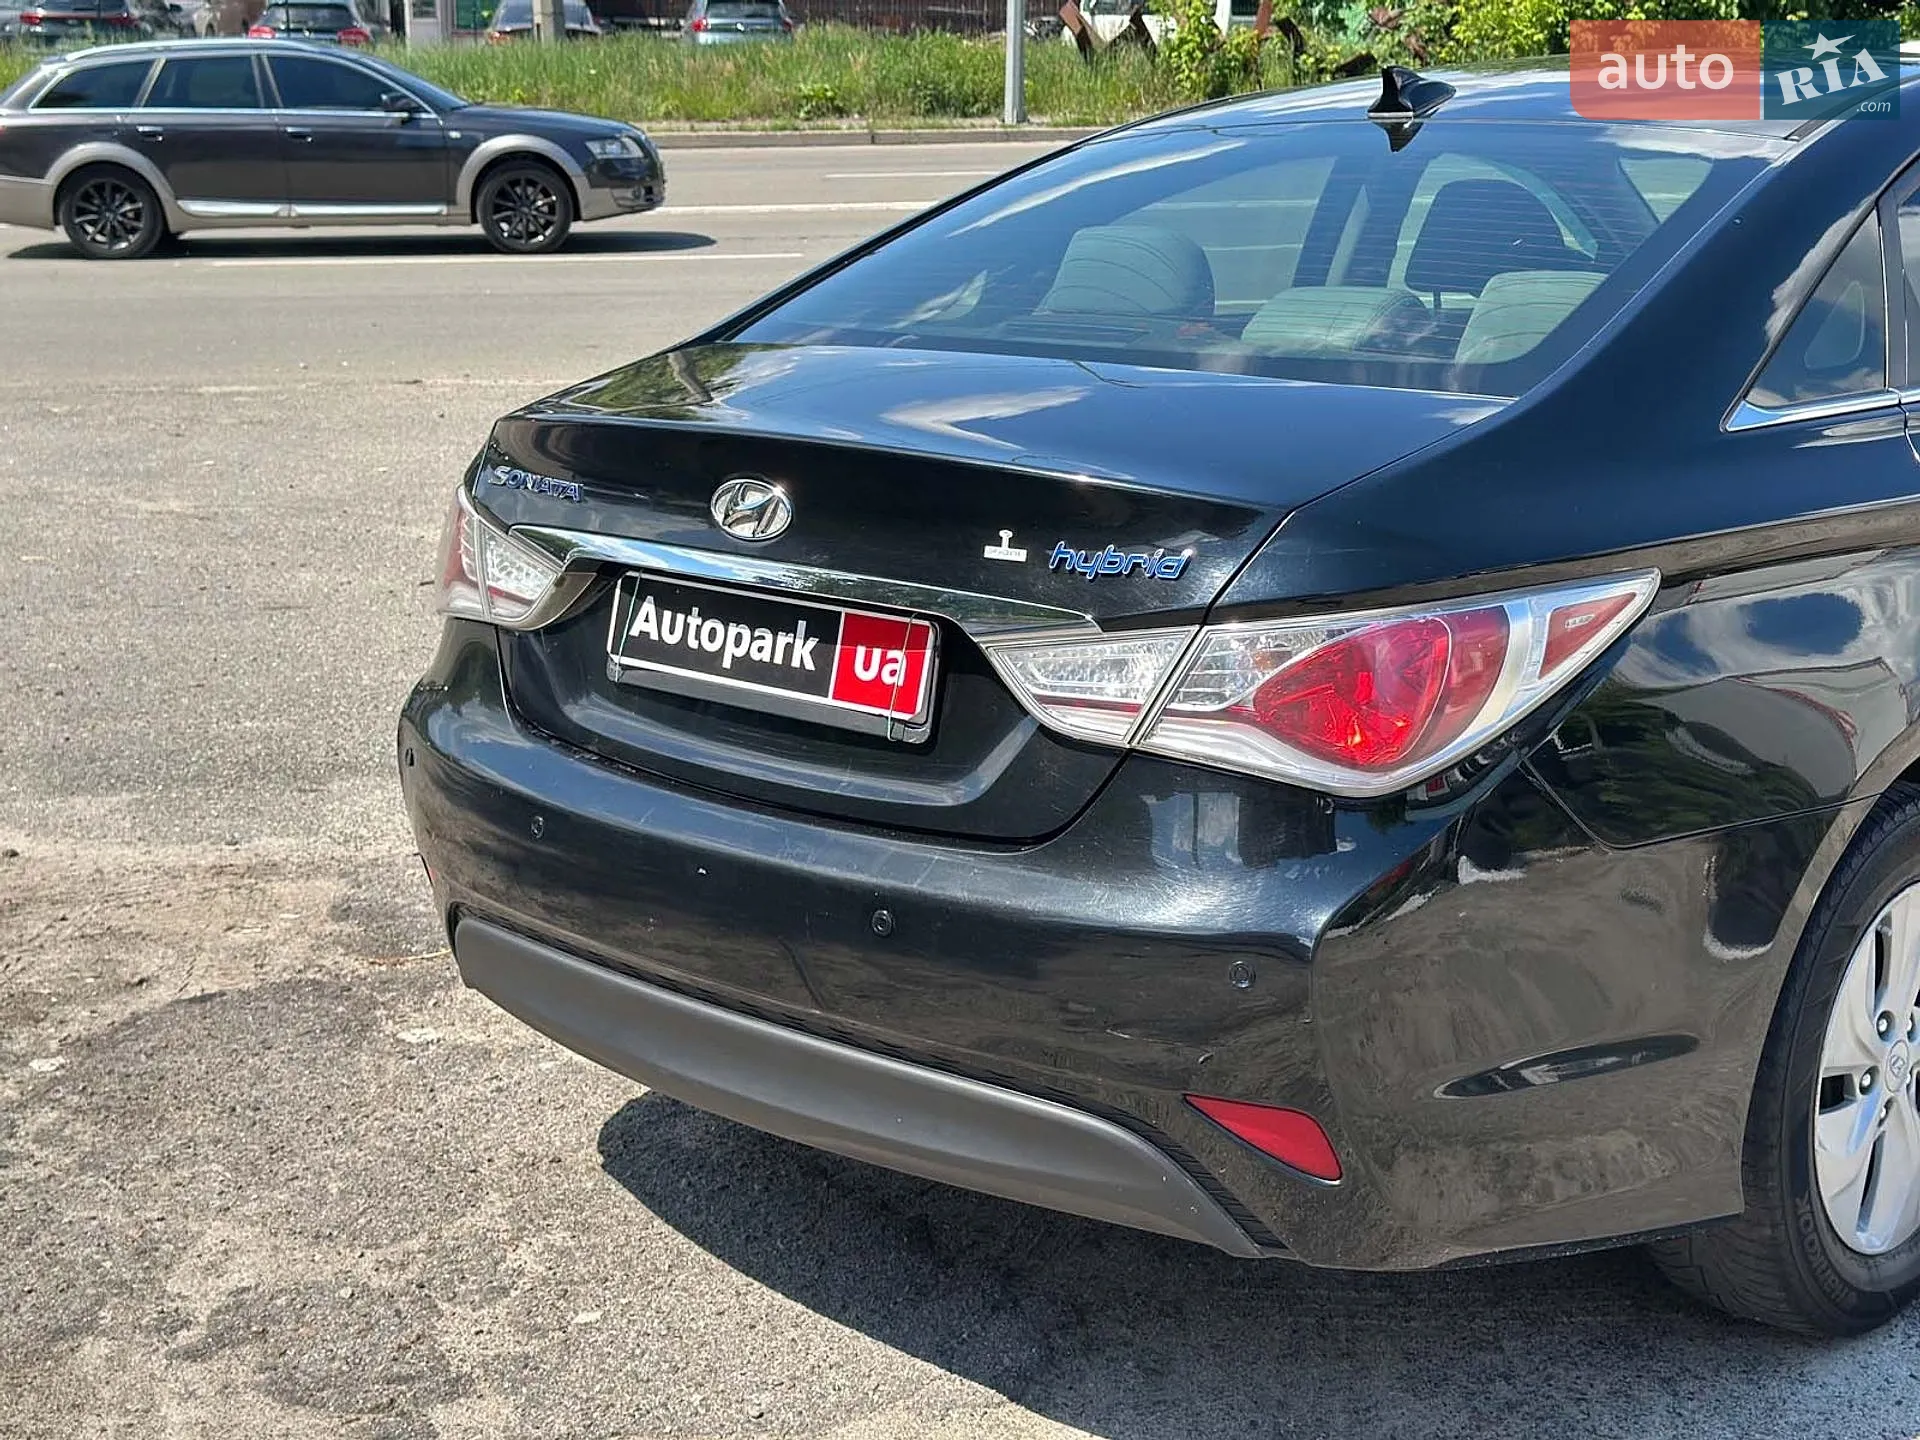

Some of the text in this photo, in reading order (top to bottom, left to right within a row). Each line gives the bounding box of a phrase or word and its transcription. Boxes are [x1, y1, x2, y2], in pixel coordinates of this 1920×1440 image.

[488, 465, 584, 502] SONATA
[1049, 540, 1194, 580] hybrid
[628, 595, 908, 687] Autopark ua
